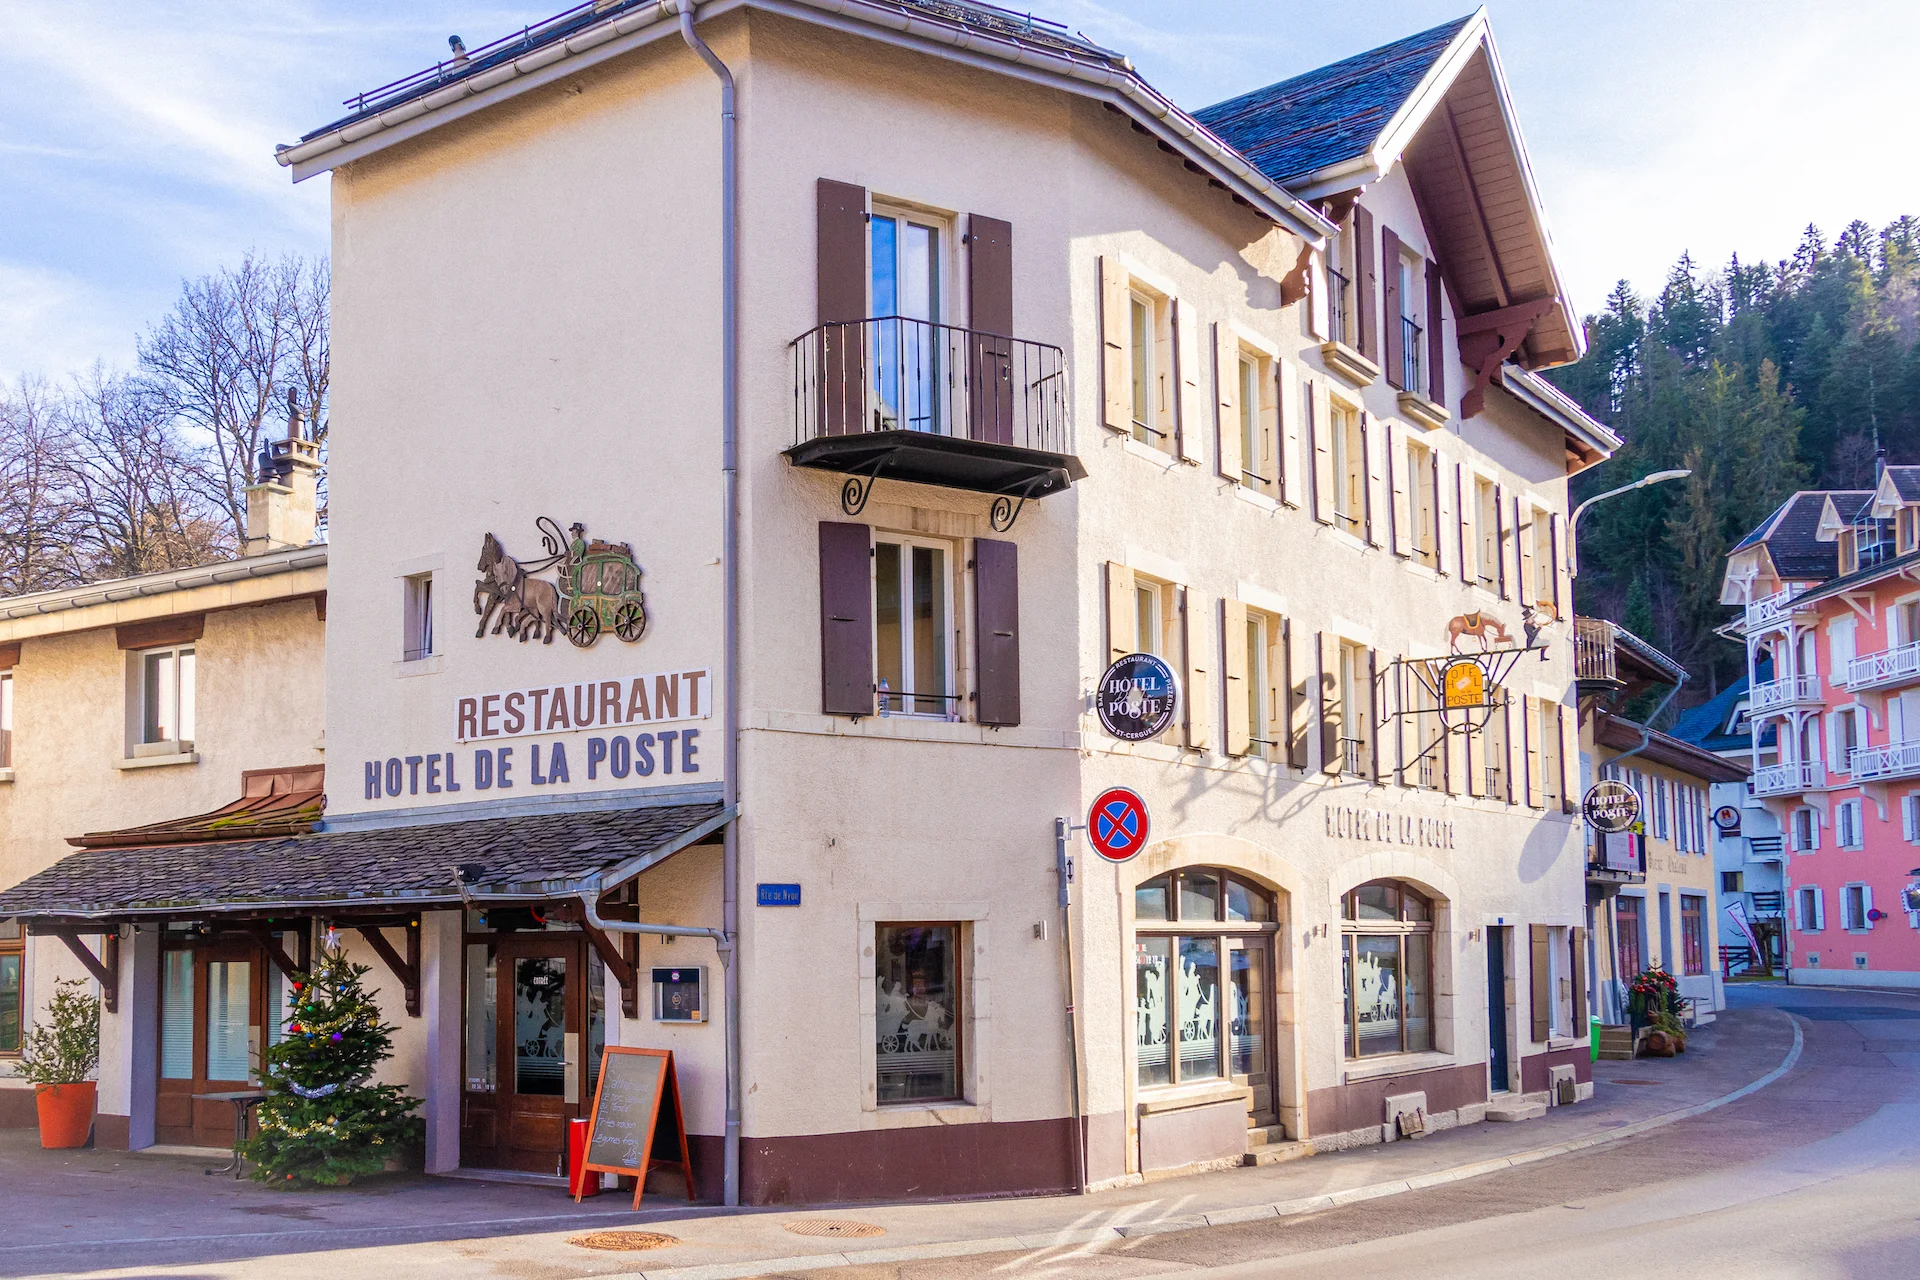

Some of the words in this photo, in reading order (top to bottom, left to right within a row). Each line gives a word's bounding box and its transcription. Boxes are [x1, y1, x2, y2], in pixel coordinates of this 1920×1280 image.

[1115, 656, 1157, 669] RESTAURANT
[1164, 678, 1174, 711] PIZZERIA
[1447, 693, 1482, 706] POSTE
[457, 669, 706, 740] RESTAURANT
[1109, 698, 1162, 719] POSTE
[364, 752, 460, 800] HOTEL
[474, 747, 513, 790] DE
[530, 742, 570, 785] LA
[587, 728, 699, 780] POSTE
[1592, 808, 1630, 820] POSTE
[774, 890, 781, 900] de
[783, 889, 798, 902] Nyon
